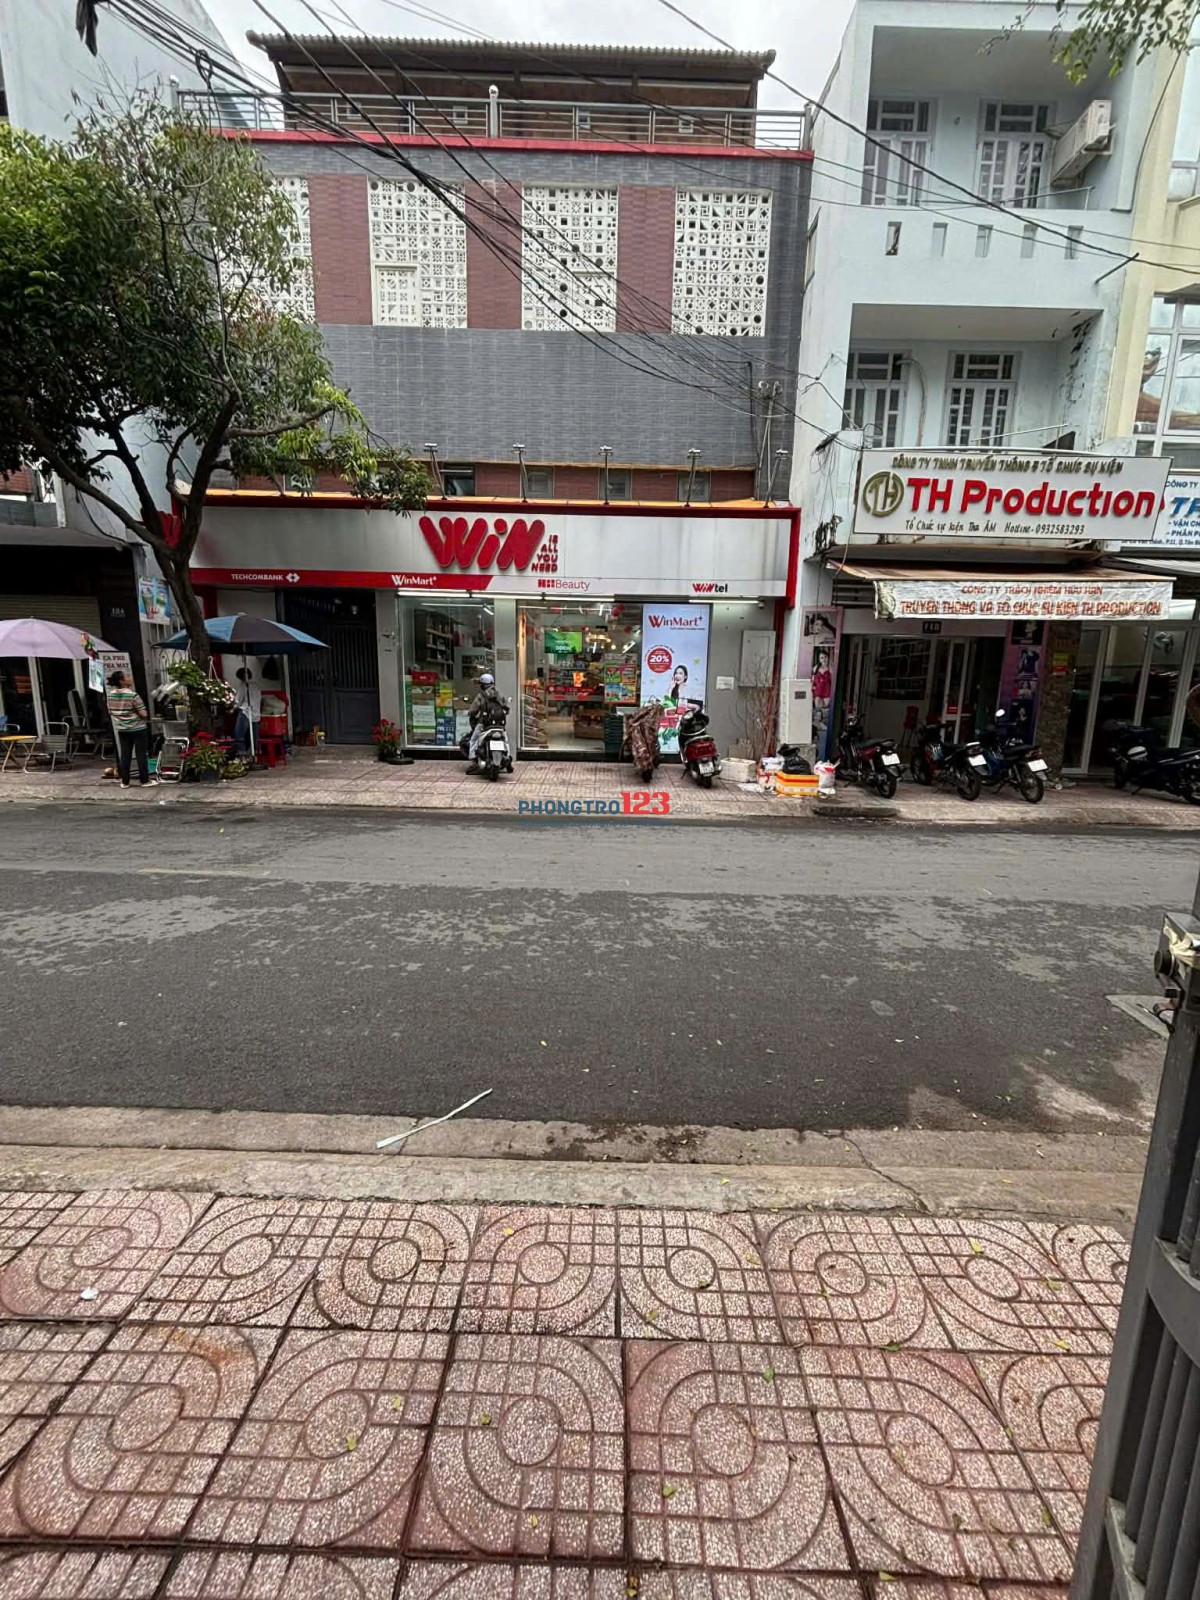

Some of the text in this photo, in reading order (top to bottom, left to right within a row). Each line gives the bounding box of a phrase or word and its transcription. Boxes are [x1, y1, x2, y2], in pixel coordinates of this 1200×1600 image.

[919, 456, 931, 470] TY
[1165, 479, 1188, 488] CÔNG
[907, 477, 1156, 518] TH Production
[1173, 519, 1189, 528] VẬN
[540, 543, 558, 553] ALL
[536, 553, 558, 562] YOU
[531, 562, 558, 573] NEED
[231, 573, 283, 581] TECHCOMBANK
[989, 586, 1000, 594] TY
[649, 655, 670, 663] 20%
